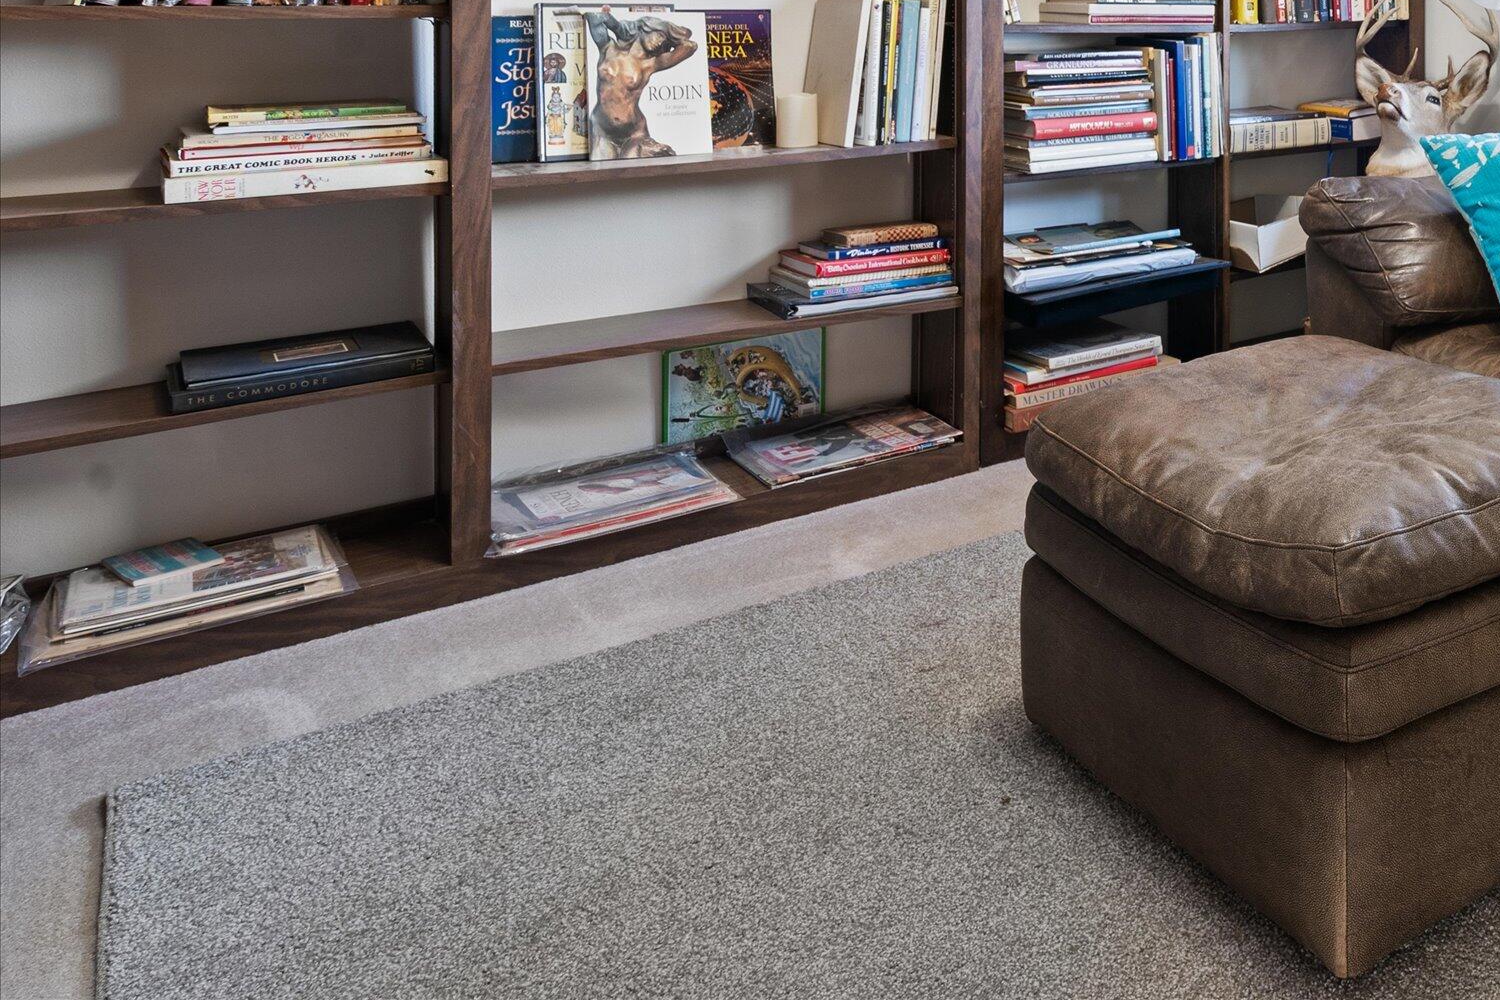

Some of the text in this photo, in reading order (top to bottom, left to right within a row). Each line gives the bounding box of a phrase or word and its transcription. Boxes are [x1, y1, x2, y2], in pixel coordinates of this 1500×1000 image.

[734, 24, 750, 32] DEL
[1046, 60, 1096, 69] GRANLUND
[512, 81, 534, 104] of
[648, 85, 702, 102] RODIN
[1048, 138, 1074, 146] NORMAN
[1074, 136, 1105, 144] ROCKWELL
[178, 149, 414, 174] THE GREAT COMIC BOOK HEROES Jules Feiffer
[868, 256, 903, 268] International
[902, 254, 929, 266] Cookbook
[188, 376, 329, 405] THE COMMODORE
[1022, 387, 1066, 405] MASTER
